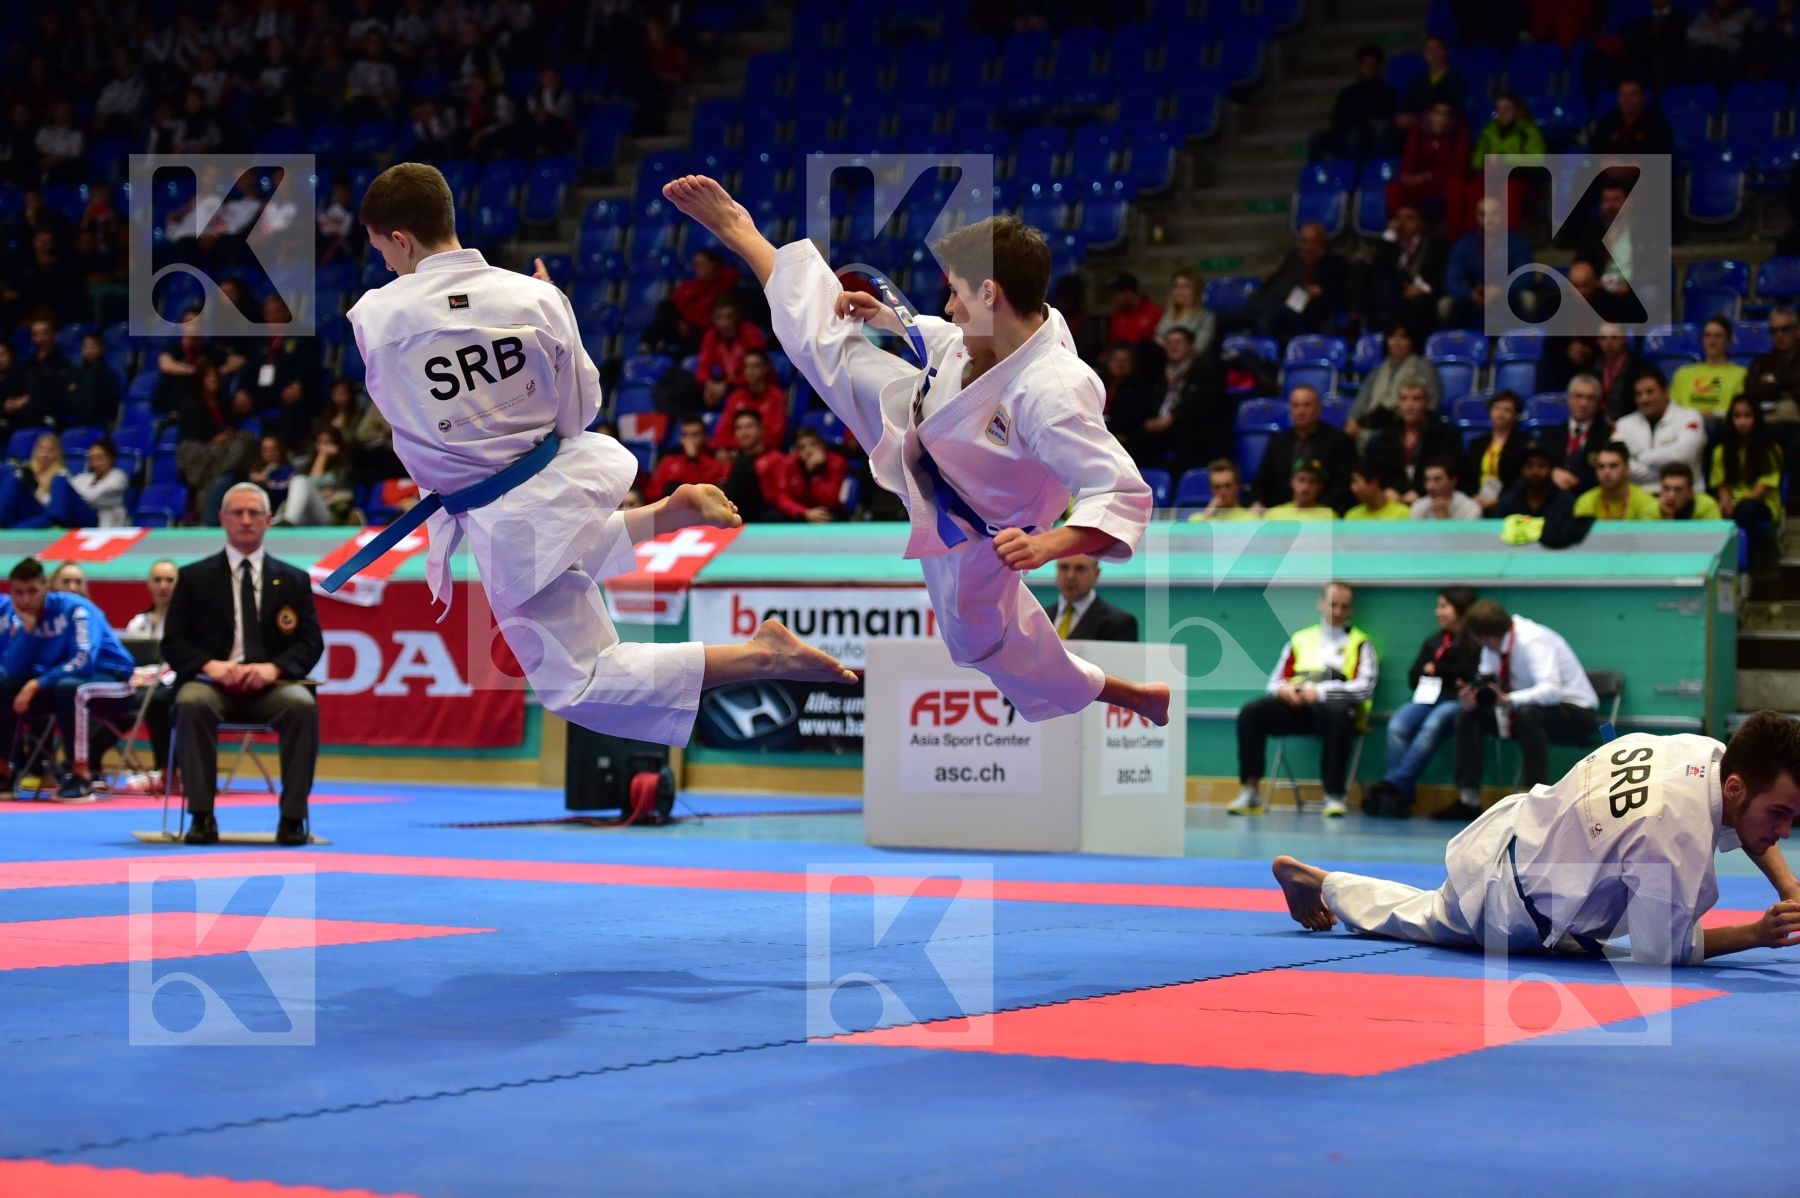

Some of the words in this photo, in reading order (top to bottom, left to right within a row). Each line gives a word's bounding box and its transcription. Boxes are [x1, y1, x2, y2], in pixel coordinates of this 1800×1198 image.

[424, 336, 526, 401] SRB
[910, 690, 998, 726] ASC
[911, 734, 940, 746] Asia
[943, 733, 981, 749] Sport
[984, 733, 1031, 747] Center
[935, 763, 1005, 782] asc.ch
[1609, 747, 1654, 819] SRB
